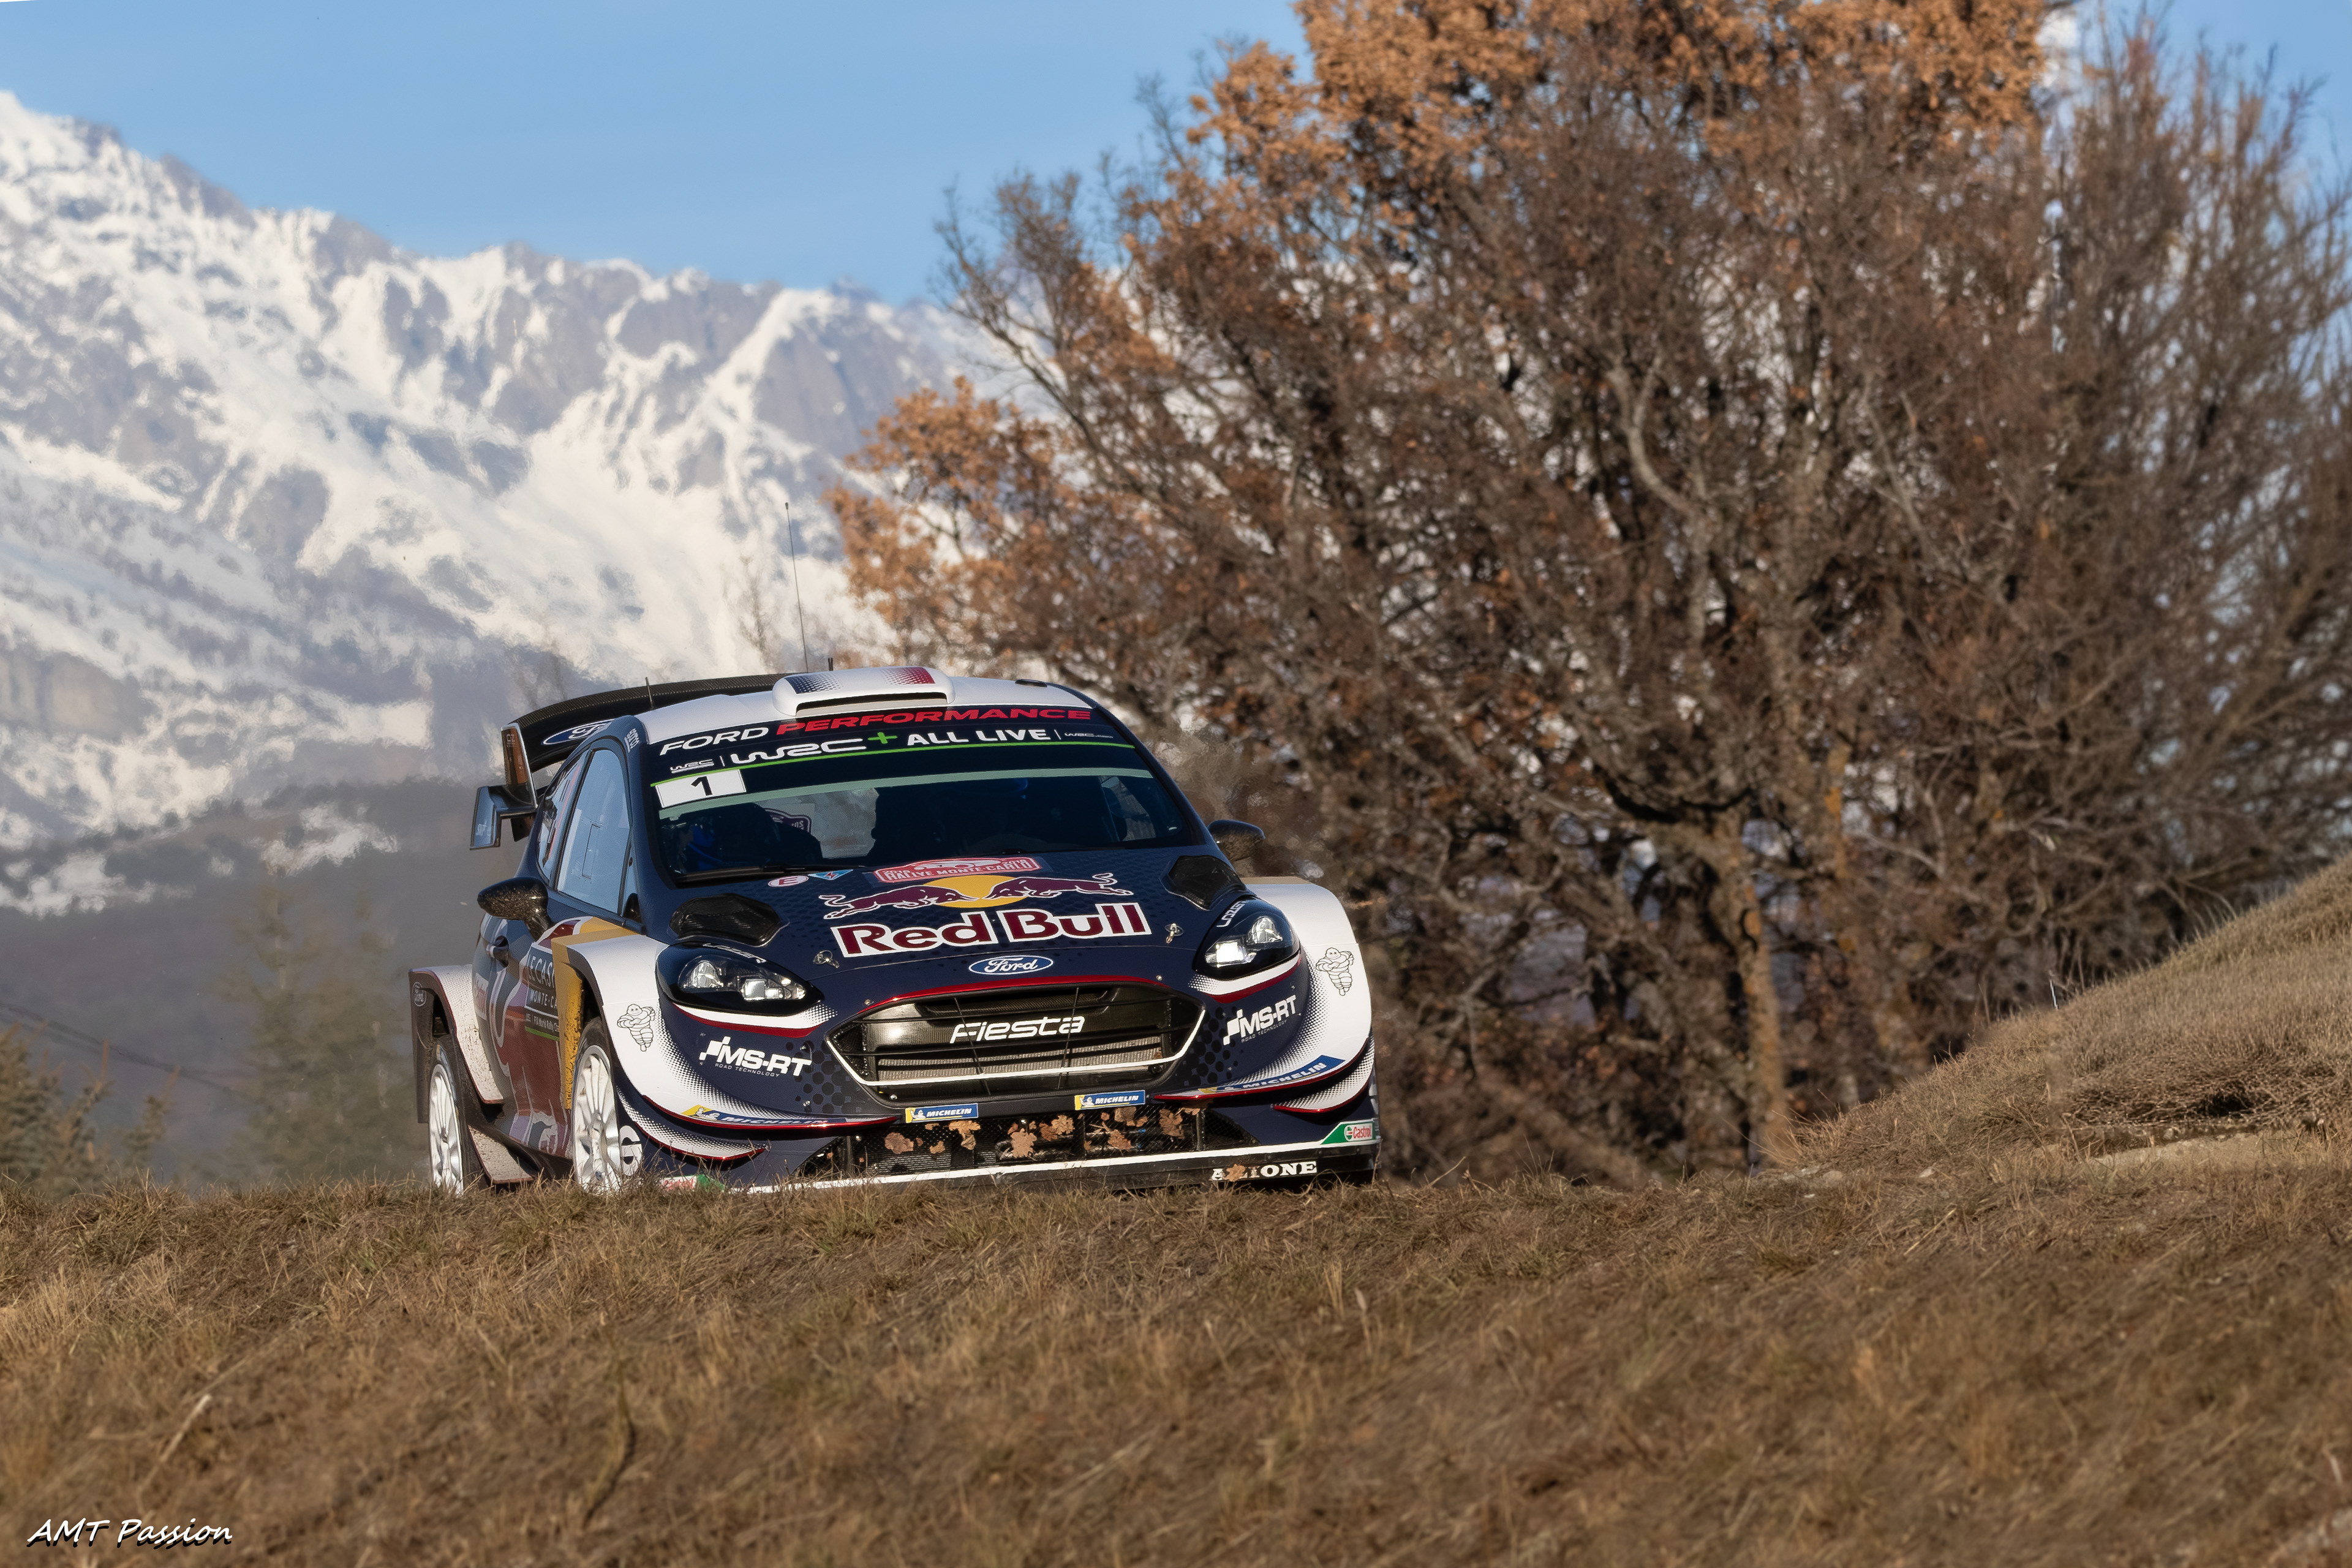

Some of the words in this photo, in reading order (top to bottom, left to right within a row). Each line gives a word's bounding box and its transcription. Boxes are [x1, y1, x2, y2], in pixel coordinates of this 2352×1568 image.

[659, 727, 769, 756] FORD
[776, 709, 1091, 735] PERFORMANCE
[907, 731, 969, 746] ALL
[976, 729, 1051, 742] LIVE
[691, 775, 713, 796] 1
[884, 870, 935, 881] RALLYE
[833, 912, 996, 956] Red
[1000, 903, 1150, 942] Bull
[985, 956, 1038, 973] Ford
[735, 1066, 780, 1078] TECHNOLOGY
[1243, 1062, 1327, 1088] MICHELIN
[1095, 1095, 1139, 1104] MICHELIN
[927, 1108, 972, 1117] MICHELIN
[1353, 1126, 1372, 1139] Castrol
